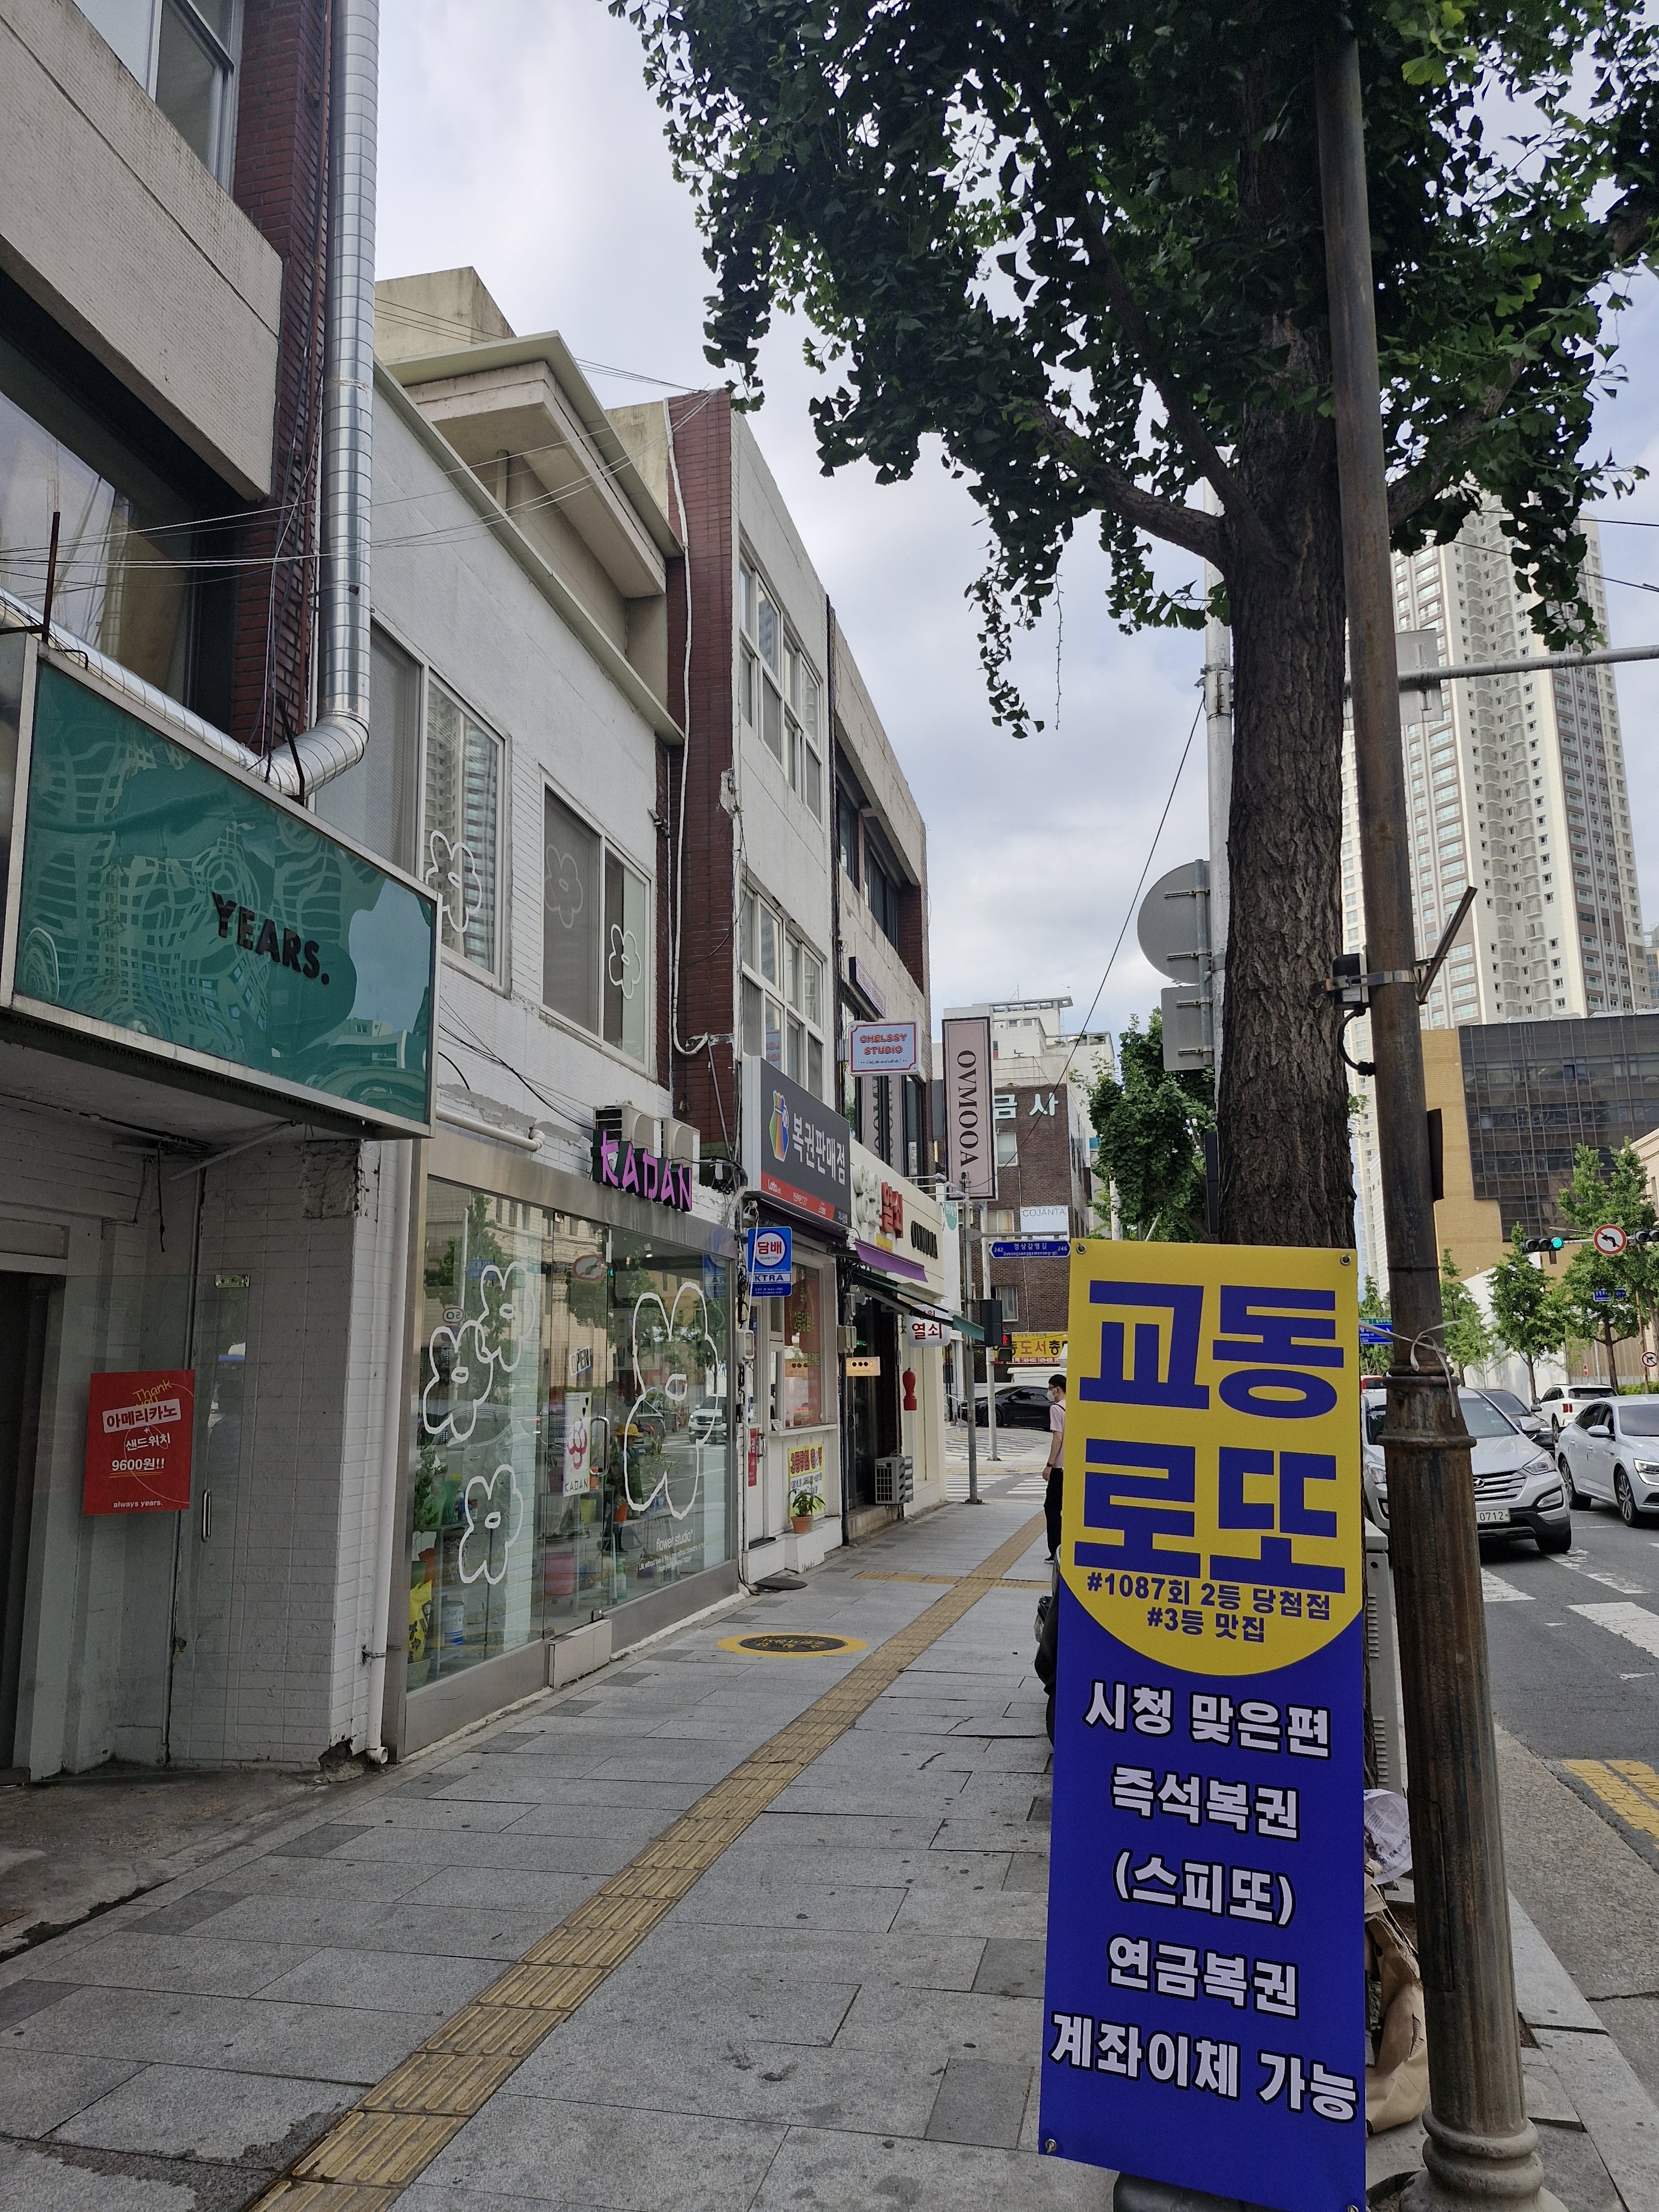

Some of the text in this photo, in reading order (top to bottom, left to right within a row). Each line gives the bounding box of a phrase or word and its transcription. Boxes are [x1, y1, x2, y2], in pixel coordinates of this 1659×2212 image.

[212, 891, 331, 985] YEARS.
[859, 1034, 907, 1043] CHELSSY
[864, 1046, 902, 1055] STUDIO
[957, 1050, 979, 1167] OVMOOA
[792, 1114, 846, 1185] 복권판매점
[601, 1130, 692, 1212] KADAN
[1022, 1208, 1065, 1217] COJANTA
[758, 1241, 782, 1254] 담배
[912, 1323, 942, 1340] 열쇠
[571, 1348, 589, 1374] OPEN
[1079, 1280, 1344, 1419] 교동
[132, 1379, 173, 1403] Thank
[105, 1404, 178, 1429] 아메리카노
[125, 1433, 171, 1452] 샌드위치
[112, 1458, 165, 1473] 9600원!!
[790, 1449, 810, 1474] 3등당첨
[113, 1499, 164, 1509] always years.
[1074, 1438, 1346, 1594] 로또
[1480, 1511, 1504, 1521] 0712
[656, 1536, 674, 1552] flower
[1087, 1571, 1331, 1620] #1087회 2등 당첨점
[1147, 1607, 1265, 1642] #3등 맛집
[1085, 1681, 1330, 1757] 시청 맞은편
[1113, 1767, 1298, 1839] 즉석복권
[1115, 1851, 1295, 1925] (스피또)
[1109, 1937, 1297, 2016] 연금복권
[1051, 2013, 1358, 2120] 계좌이체 가능
